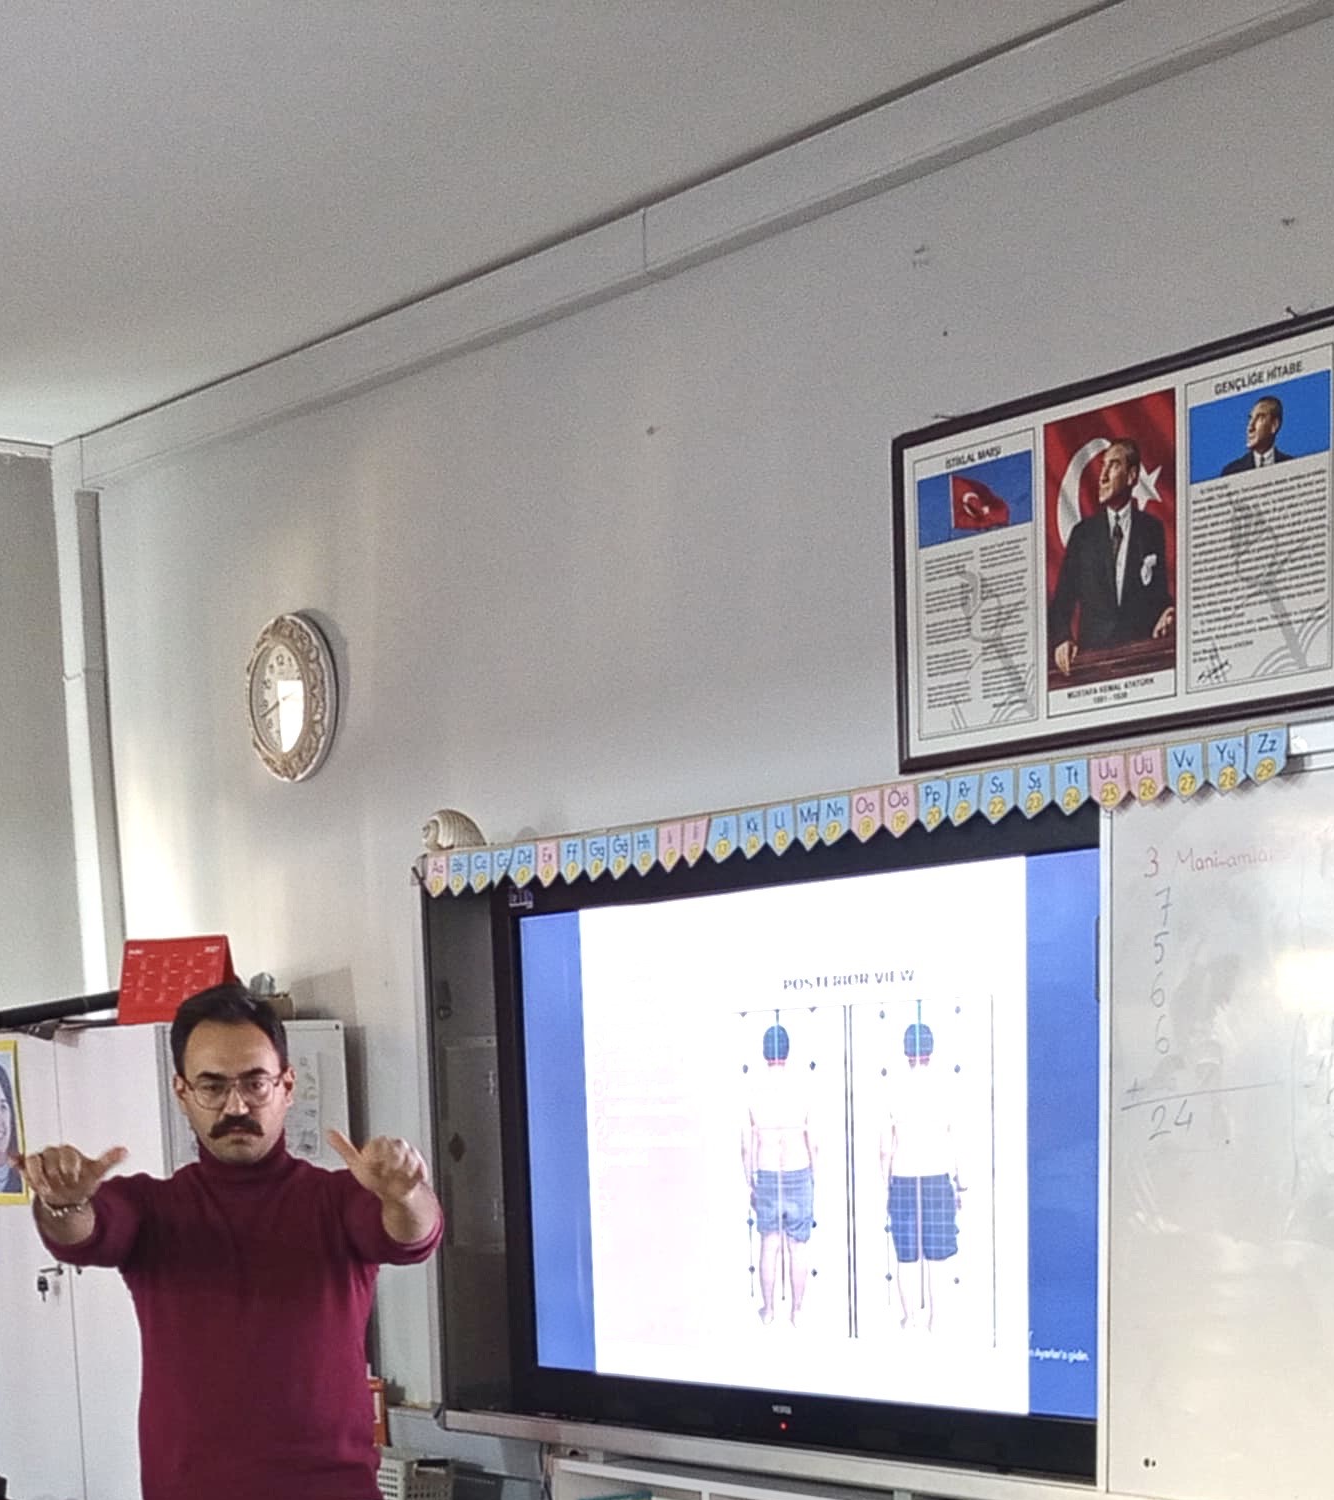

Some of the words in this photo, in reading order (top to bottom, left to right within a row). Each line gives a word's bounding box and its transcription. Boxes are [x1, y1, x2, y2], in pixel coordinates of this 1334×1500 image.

[1266, 359, 1303, 383] HİTABE
[855, 796, 875, 813] Oo
[888, 790, 910, 807] Öö
[924, 785, 941, 806] Pp
[959, 782, 971, 798] Rr
[990, 776, 1004, 793] Ss
[1067, 766, 1079, 784] Tt
[1099, 762, 1118, 780] Uu
[1174, 750, 1195, 768] Vv
[1216, 744, 1237, 766] Yy
[1257, 733, 1277, 753] Zz
[894, 815, 907, 829] 19
[927, 809, 941, 823] 20
[990, 799, 1005, 813] 22
[1028, 794, 1042, 809] 23
[1065, 792, 1080, 808] 24
[1102, 786, 1118, 803] 25
[1139, 782, 1155, 797] 26
[1179, 777, 1195, 792] 27
[1219, 771, 1237, 787] 28
[1257, 762, 1274, 778] 29
[1154, 885, 1172, 927] 7
[1150, 970, 1166, 1008] 6
